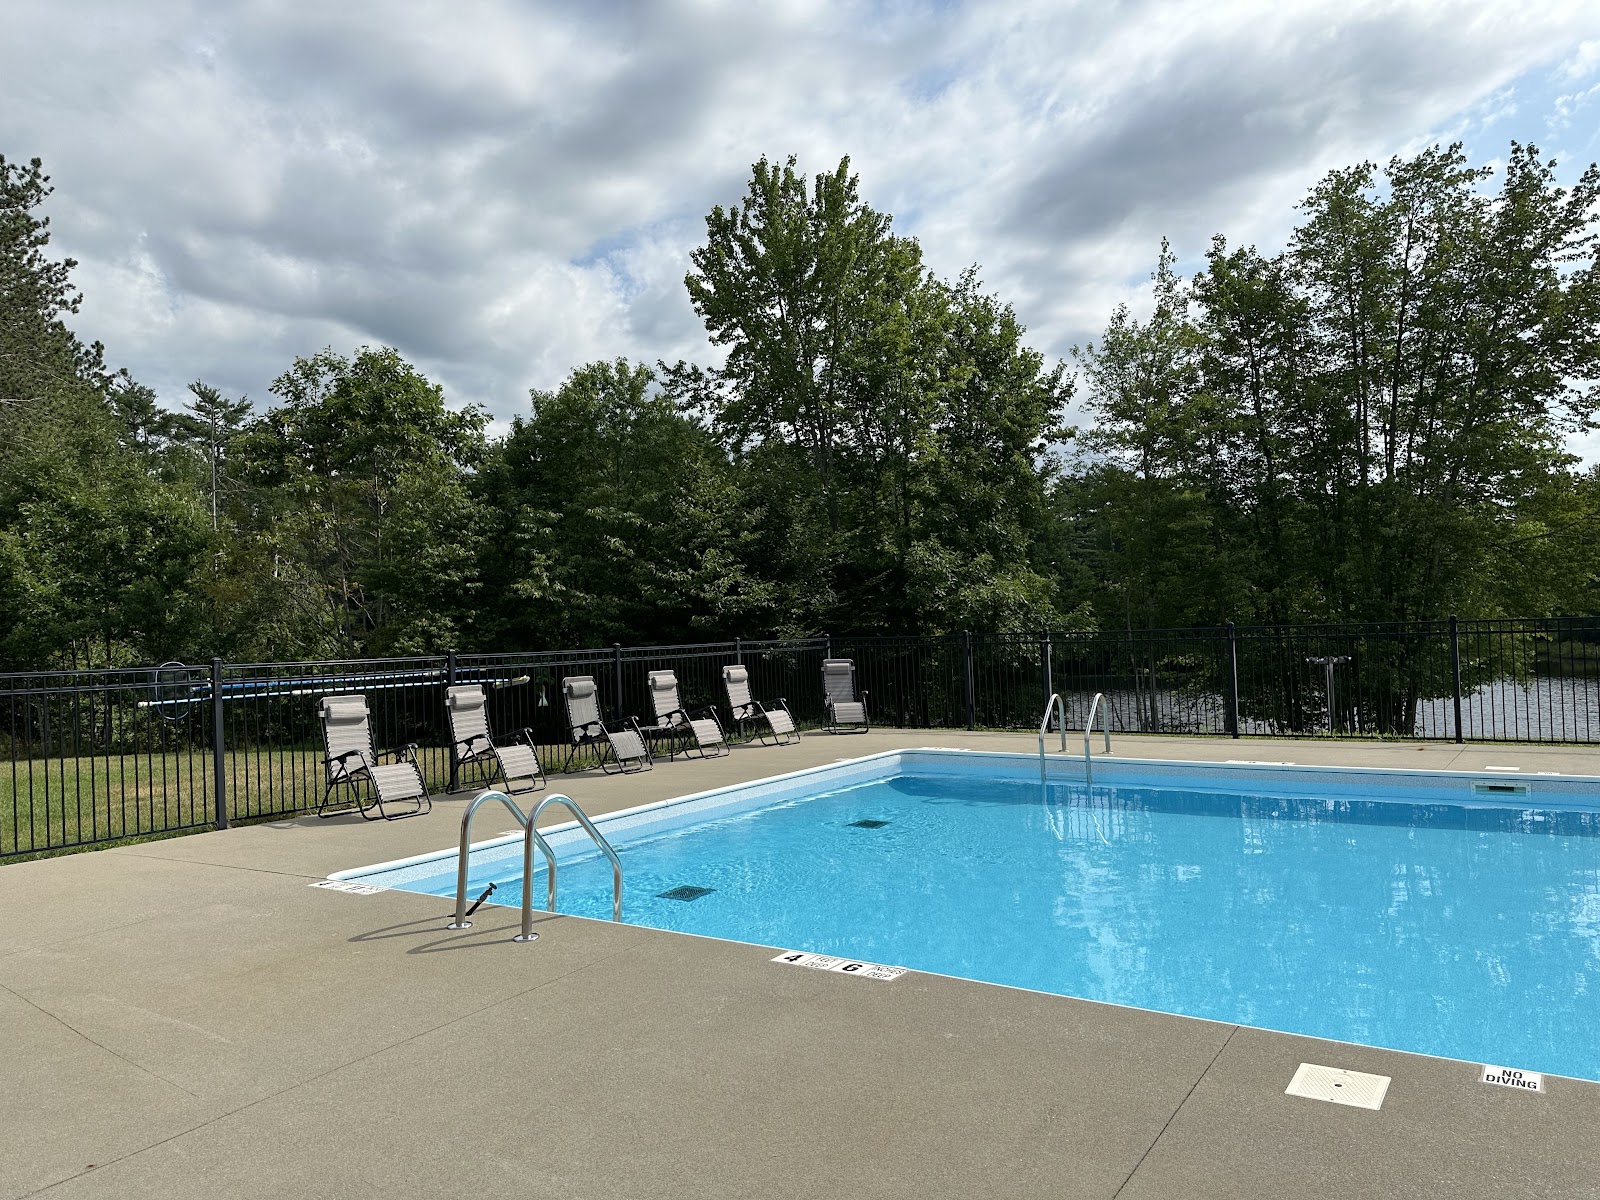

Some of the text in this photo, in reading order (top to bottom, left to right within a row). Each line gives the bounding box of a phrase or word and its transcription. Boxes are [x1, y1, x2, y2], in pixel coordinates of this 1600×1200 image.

[784, 954, 804, 963] 4
[1501, 1069, 1523, 1080] NO
[1485, 1074, 1537, 1090] DIVING
